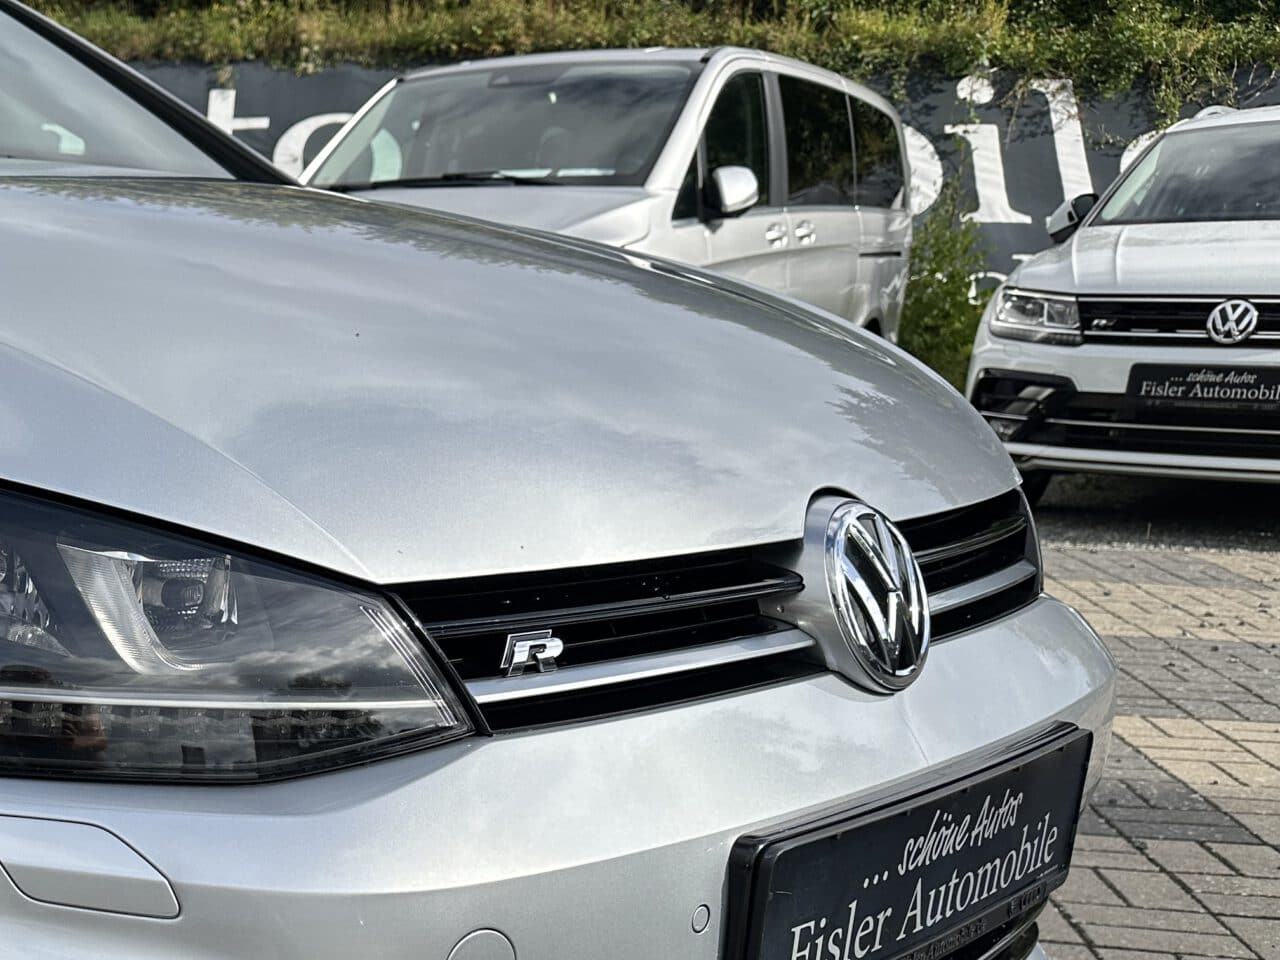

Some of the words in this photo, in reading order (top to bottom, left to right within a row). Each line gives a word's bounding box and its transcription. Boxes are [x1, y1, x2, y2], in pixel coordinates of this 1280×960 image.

[1140, 380, 1186, 397] Fisler
[1189, 383, 1280, 400] Automobil
[1224, 371, 1257, 384] Autos
[499, 629, 564, 677] R
[897, 810, 970, 877] schöne
[970, 788, 1024, 848] Autos
[895, 812, 1058, 941] Automobile
